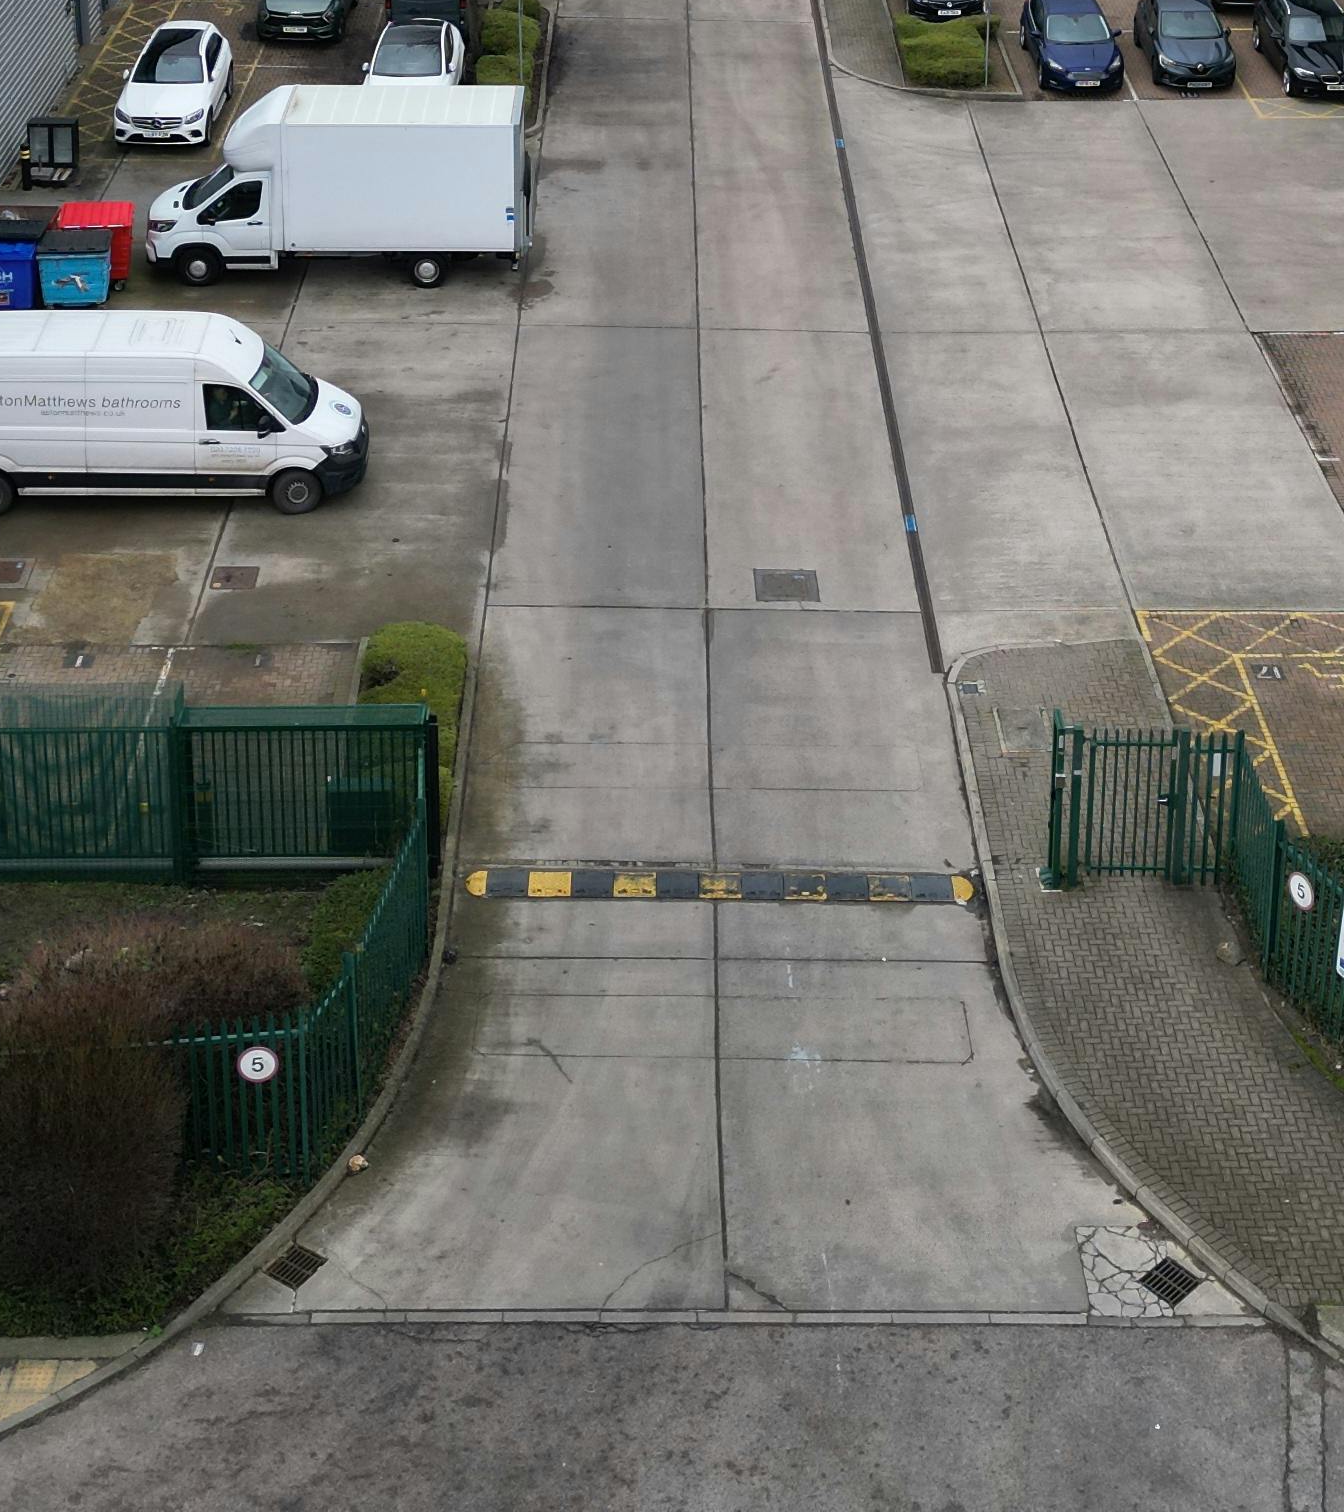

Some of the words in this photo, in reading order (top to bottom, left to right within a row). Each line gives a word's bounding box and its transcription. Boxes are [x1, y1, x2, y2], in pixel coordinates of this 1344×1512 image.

[100, 395, 182, 410] bathrooms
[1296, 883, 1306, 900] 5
[251, 1057, 265, 1073] 5
